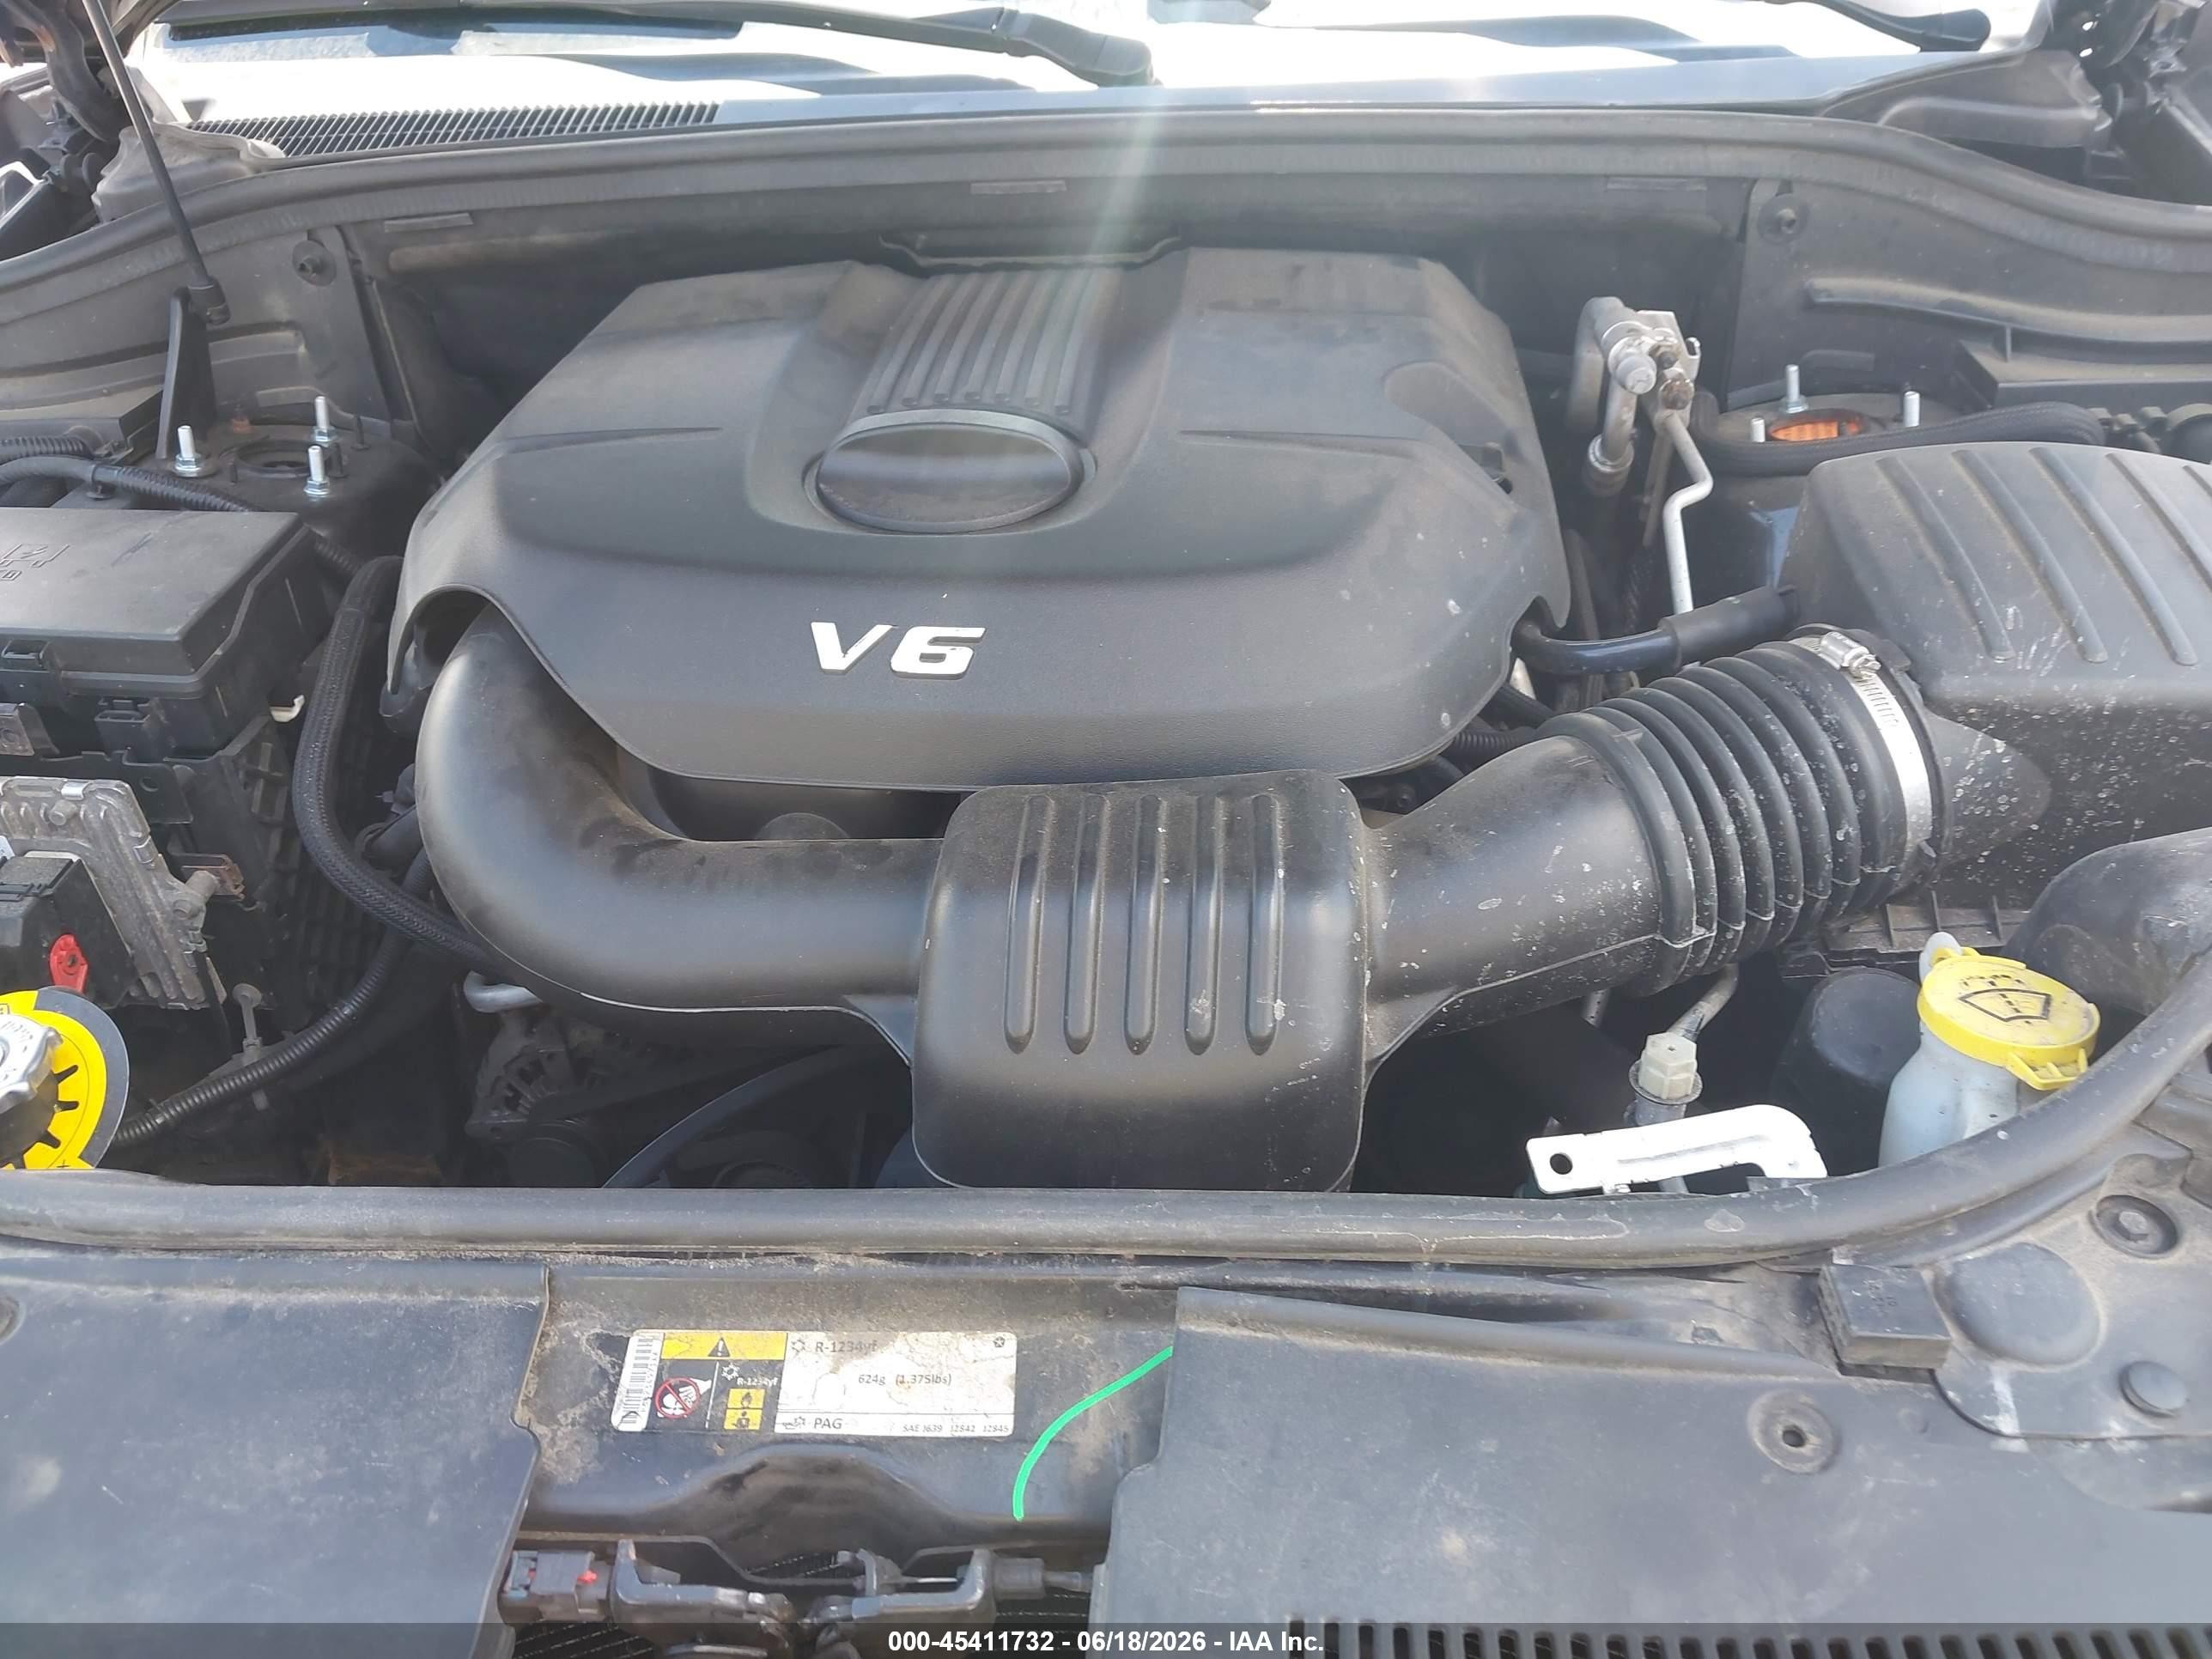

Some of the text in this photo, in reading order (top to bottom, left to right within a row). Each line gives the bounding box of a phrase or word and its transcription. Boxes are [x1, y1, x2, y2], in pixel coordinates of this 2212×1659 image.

[811, 622, 986, 680] V6
[858, 1374, 952, 1386] 624g (1.375lbs)
[814, 1418, 843, 1430] PAG
[902, 1424, 921, 1433] SAE
